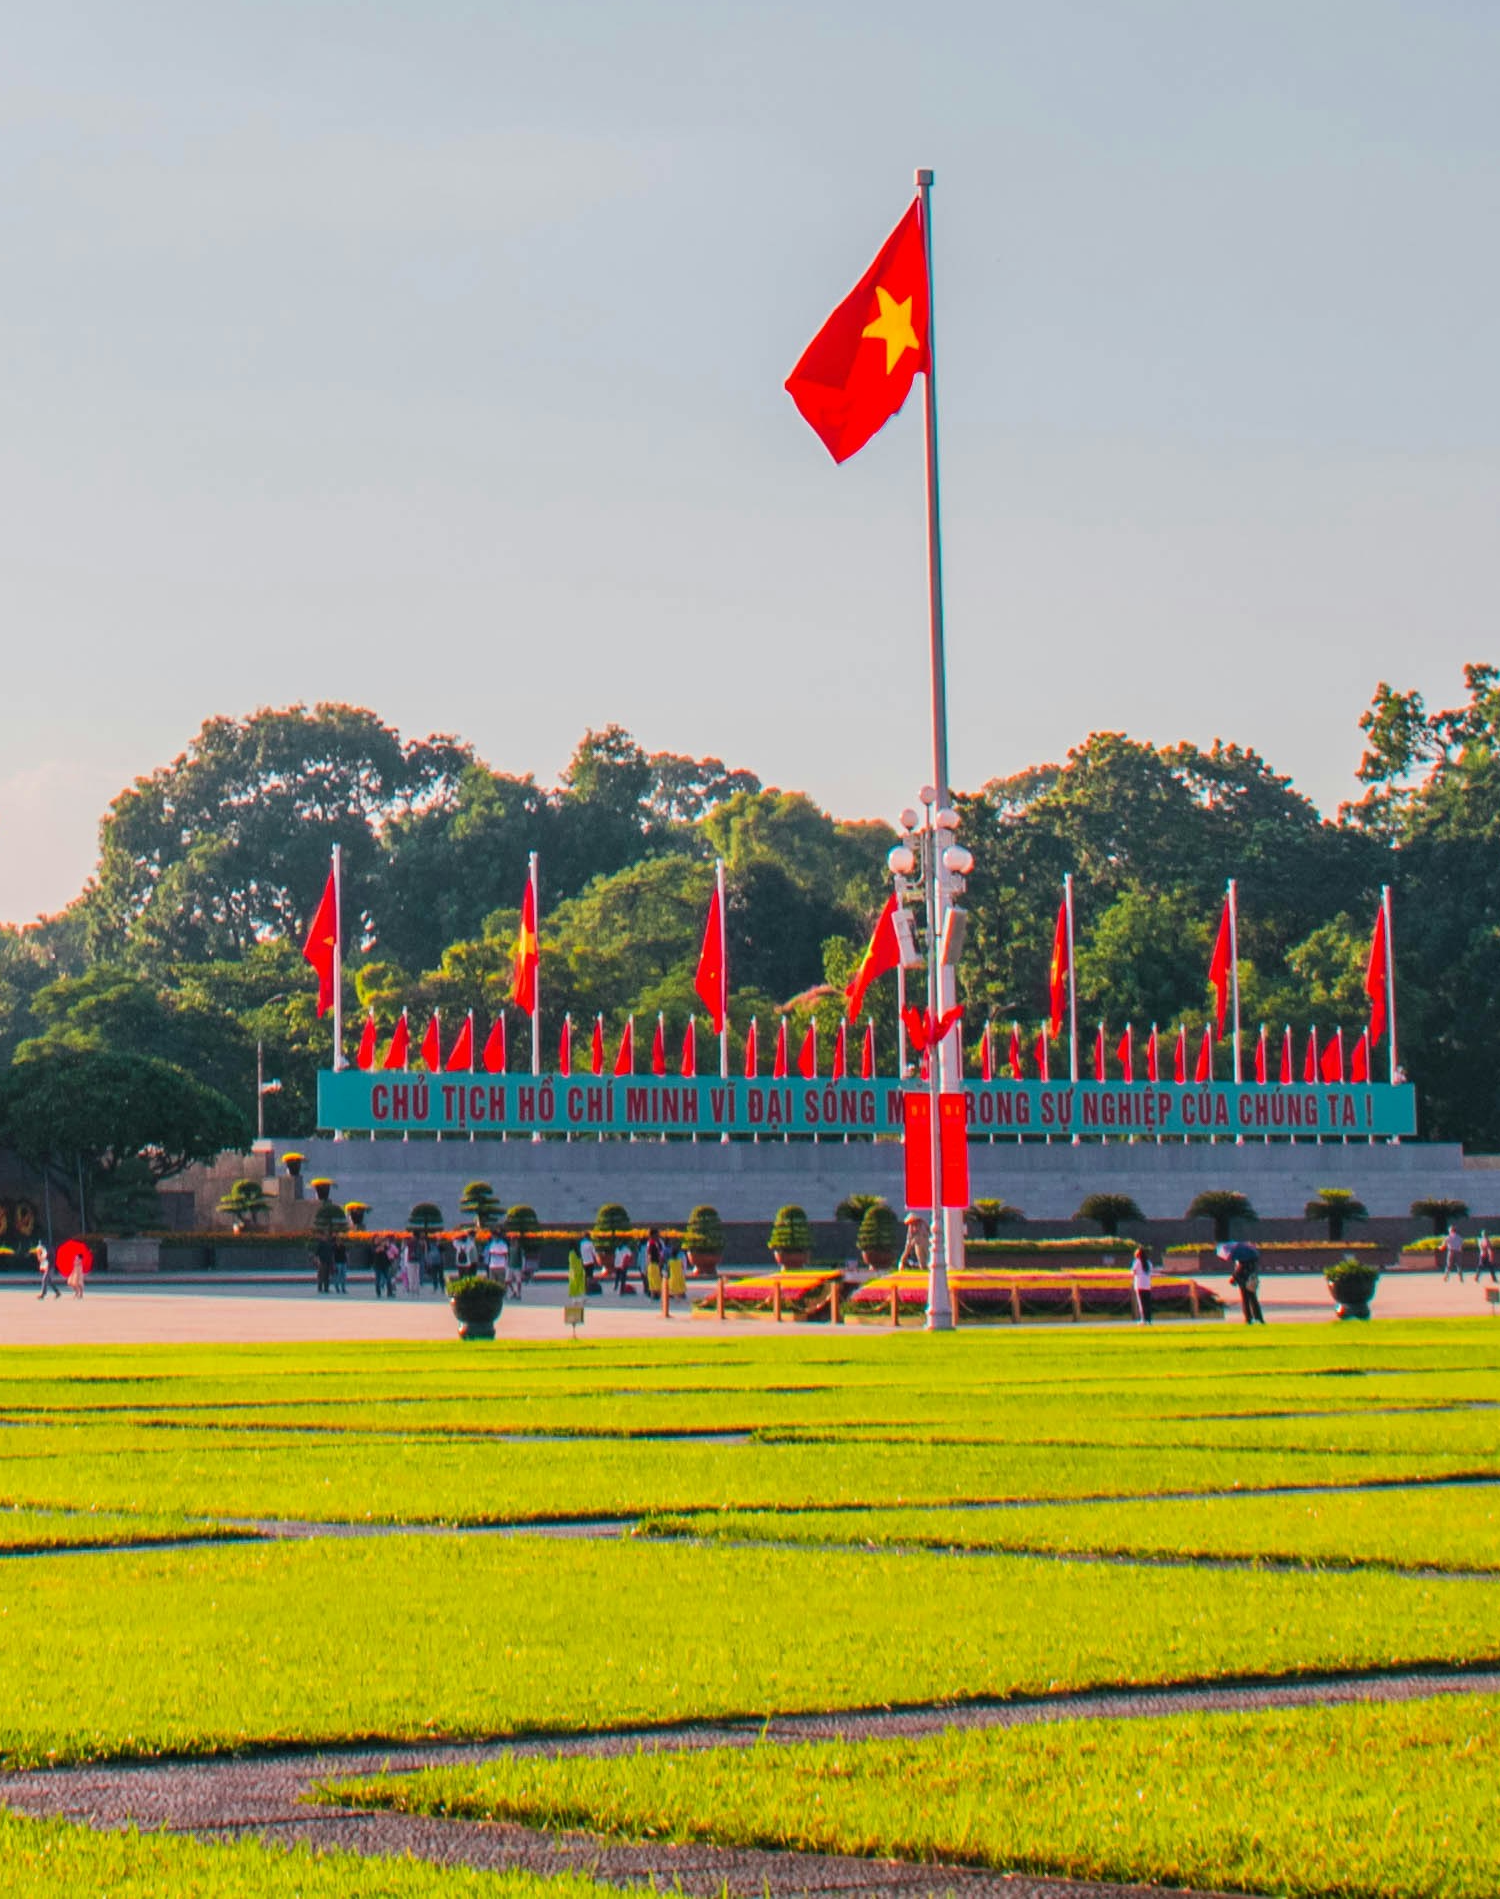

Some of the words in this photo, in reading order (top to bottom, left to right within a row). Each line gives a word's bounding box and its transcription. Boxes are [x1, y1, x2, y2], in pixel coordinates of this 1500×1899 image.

[372, 1074, 429, 1121] CHỦ
[442, 1085, 505, 1128] TỊCH
[518, 1075, 554, 1122] HỒ
[567, 1079, 613, 1123] CHÍ
[626, 1087, 698, 1123] MINH
[710, 1081, 736, 1123] VĨ
[748, 1088, 792, 1130] ĐẠI
[804, 1080, 875, 1124] SỐNG
[965, 1091, 1029, 1125] RONG
[1040, 1087, 1074, 1132] SỰ
[1082, 1085, 1172, 1132] NGHIỆP
[1181, 1084, 1230, 1127] CỦA
[1239, 1086, 1318, 1127] CHÚNG
[1327, 1093, 1356, 1127] TA
